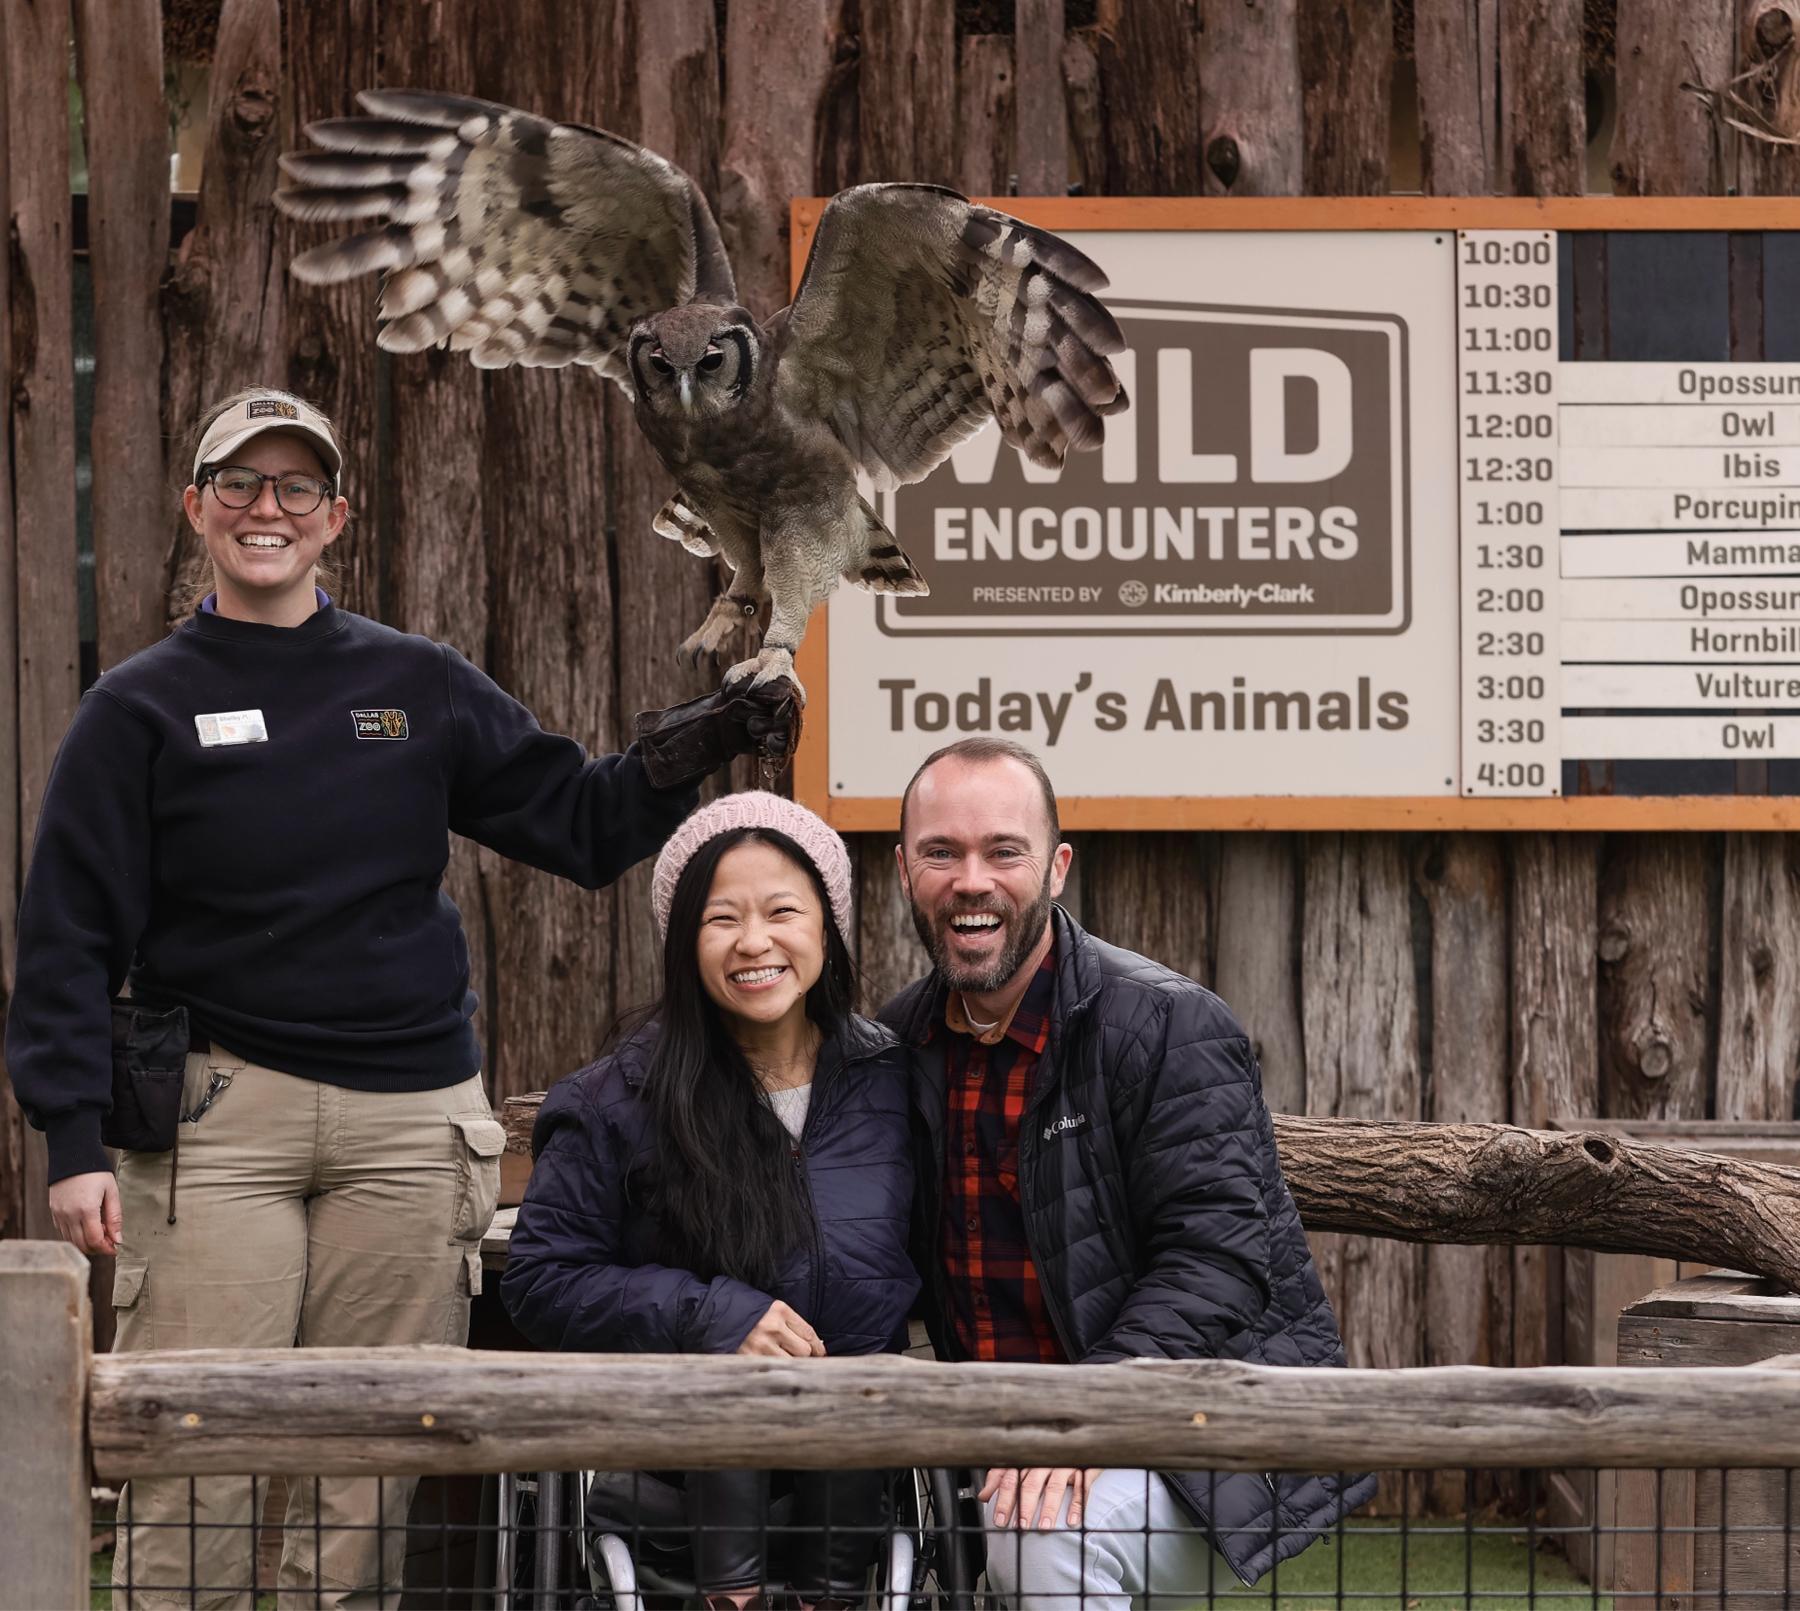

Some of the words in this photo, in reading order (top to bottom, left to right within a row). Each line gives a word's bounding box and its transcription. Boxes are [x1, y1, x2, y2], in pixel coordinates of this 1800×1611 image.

[1464, 241, 1551, 265] 10:00
[1464, 284, 1551, 309] 10:30
[1465, 327, 1552, 352] 11:00
[1465, 370, 1552, 395] 11:30
[1466, 414, 1553, 439] 12:00
[1721, 411, 1775, 437] Owl
[1466, 457, 1553, 482] 12:30
[1723, 453, 1781, 479] Ibis
[1477, 501, 1543, 525] 1:00
[934, 506, 1359, 561] ENCOUNTERS
[1477, 544, 1544, 569] 1:30
[973, 586, 1075, 603] PRESENTED
[1078, 586, 1103, 602] BY
[1154, 583, 1315, 609] Kimberly-Clark
[1477, 588, 1544, 613] 2:00
[1477, 632, 1544, 656] 2:30
[1477, 675, 1545, 700] 3:00
[1695, 672, 1800, 698] Vulture
[878, 671, 1128, 747] Today’s
[1143, 676, 1409, 731] Animals
[358, 722, 381, 731] ZOO
[1477, 719, 1545, 744] 3:30
[1722, 722, 1775, 749] Owl
[1477, 763, 1545, 788] 4:00
